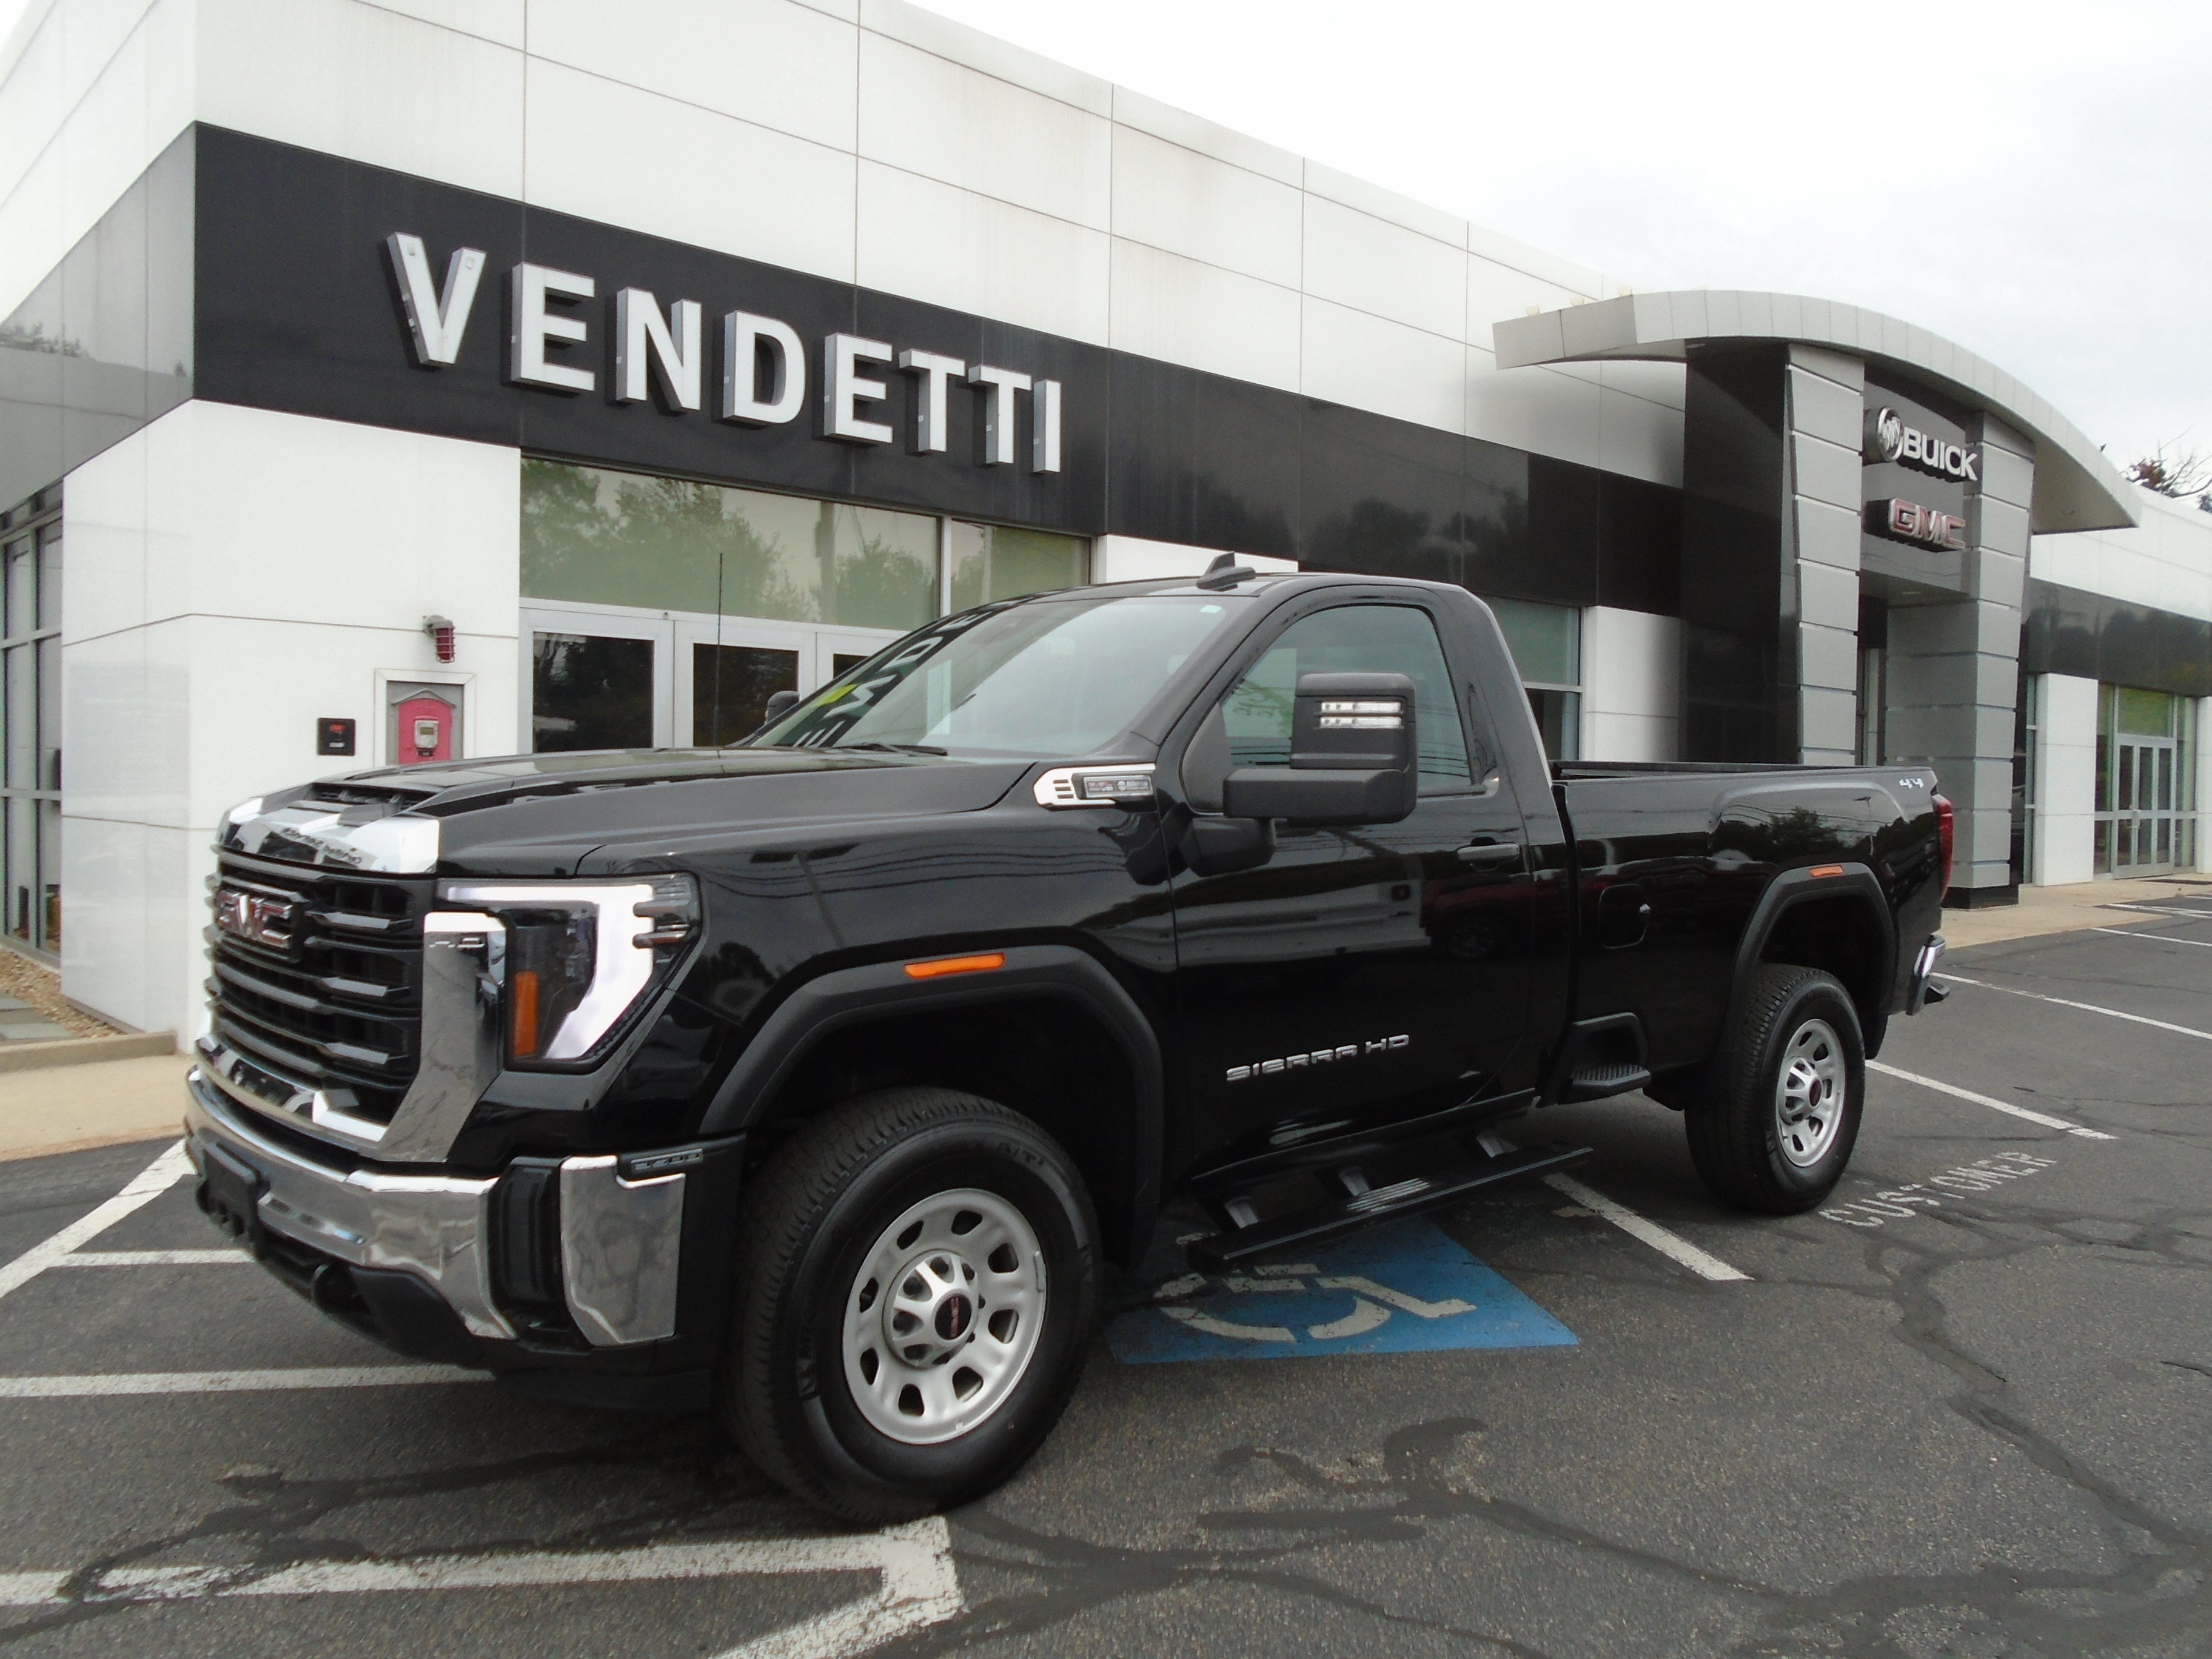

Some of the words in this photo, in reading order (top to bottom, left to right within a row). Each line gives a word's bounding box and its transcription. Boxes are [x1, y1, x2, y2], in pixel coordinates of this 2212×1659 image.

[386, 233, 1061, 474] VENDETTI
[1903, 427, 1977, 481] BUICK
[1888, 498, 1965, 549] GMC
[1226, 1044, 1358, 1081] SIERRA
[1366, 1034, 1409, 1054] HD
[1818, 1151, 2057, 1227] CUSTOMER
